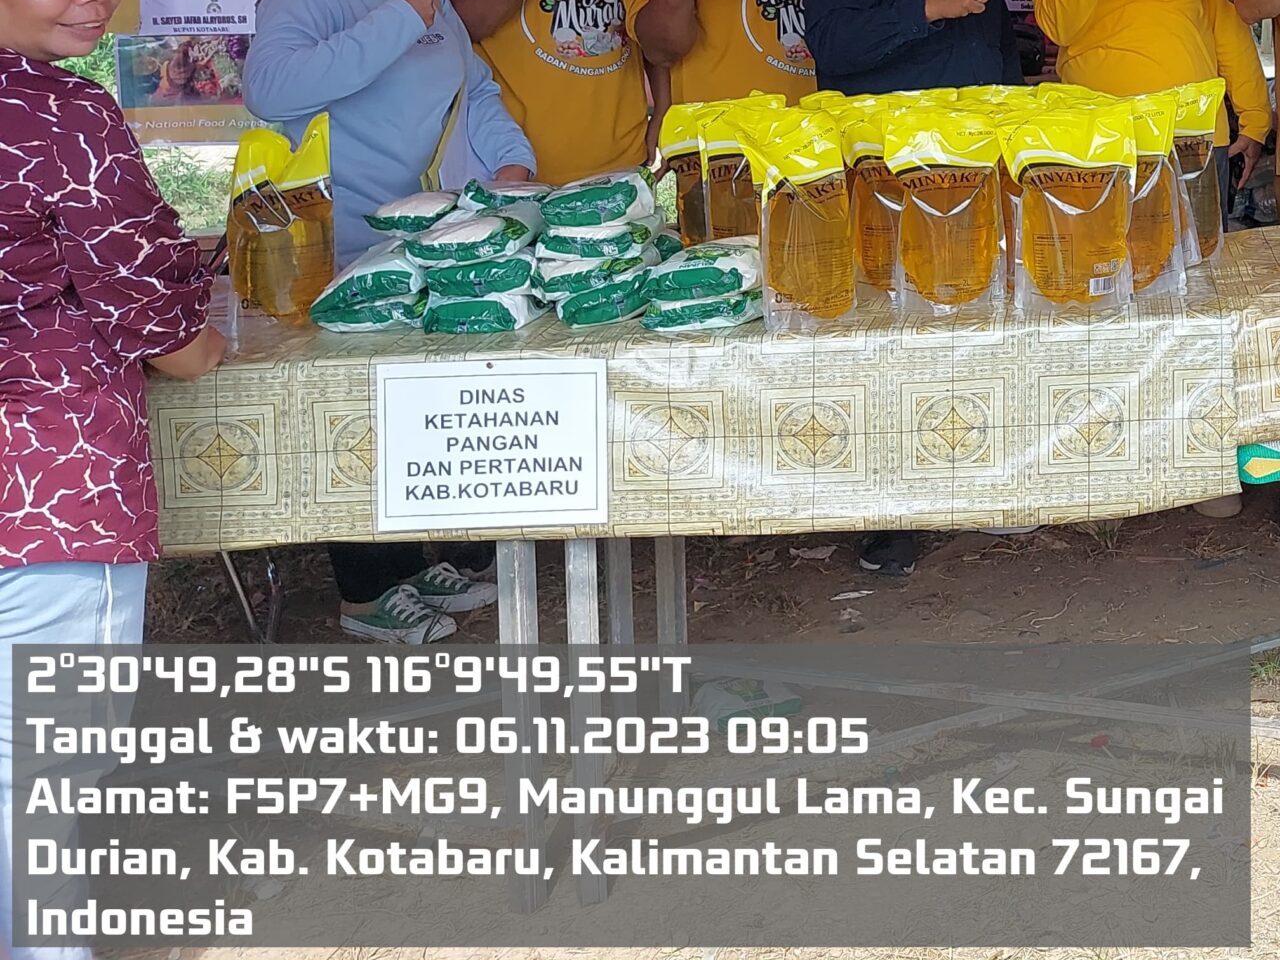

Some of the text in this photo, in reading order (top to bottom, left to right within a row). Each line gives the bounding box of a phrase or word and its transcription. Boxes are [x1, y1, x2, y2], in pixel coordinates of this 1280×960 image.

[535, 47, 567, 70] BADAN
[569, 65, 605, 76] PANGAN
[766, 55, 797, 74] BADAN
[145, 119, 196, 129] National
[198, 119, 227, 128] Food
[459, 388, 525, 406] DINAS
[424, 410, 560, 429] KETAHANAN
[446, 434, 538, 453] PANGAN
[407, 456, 583, 477] DAN PERTANIAN
[405, 480, 579, 501] KAB.KOTABARU
